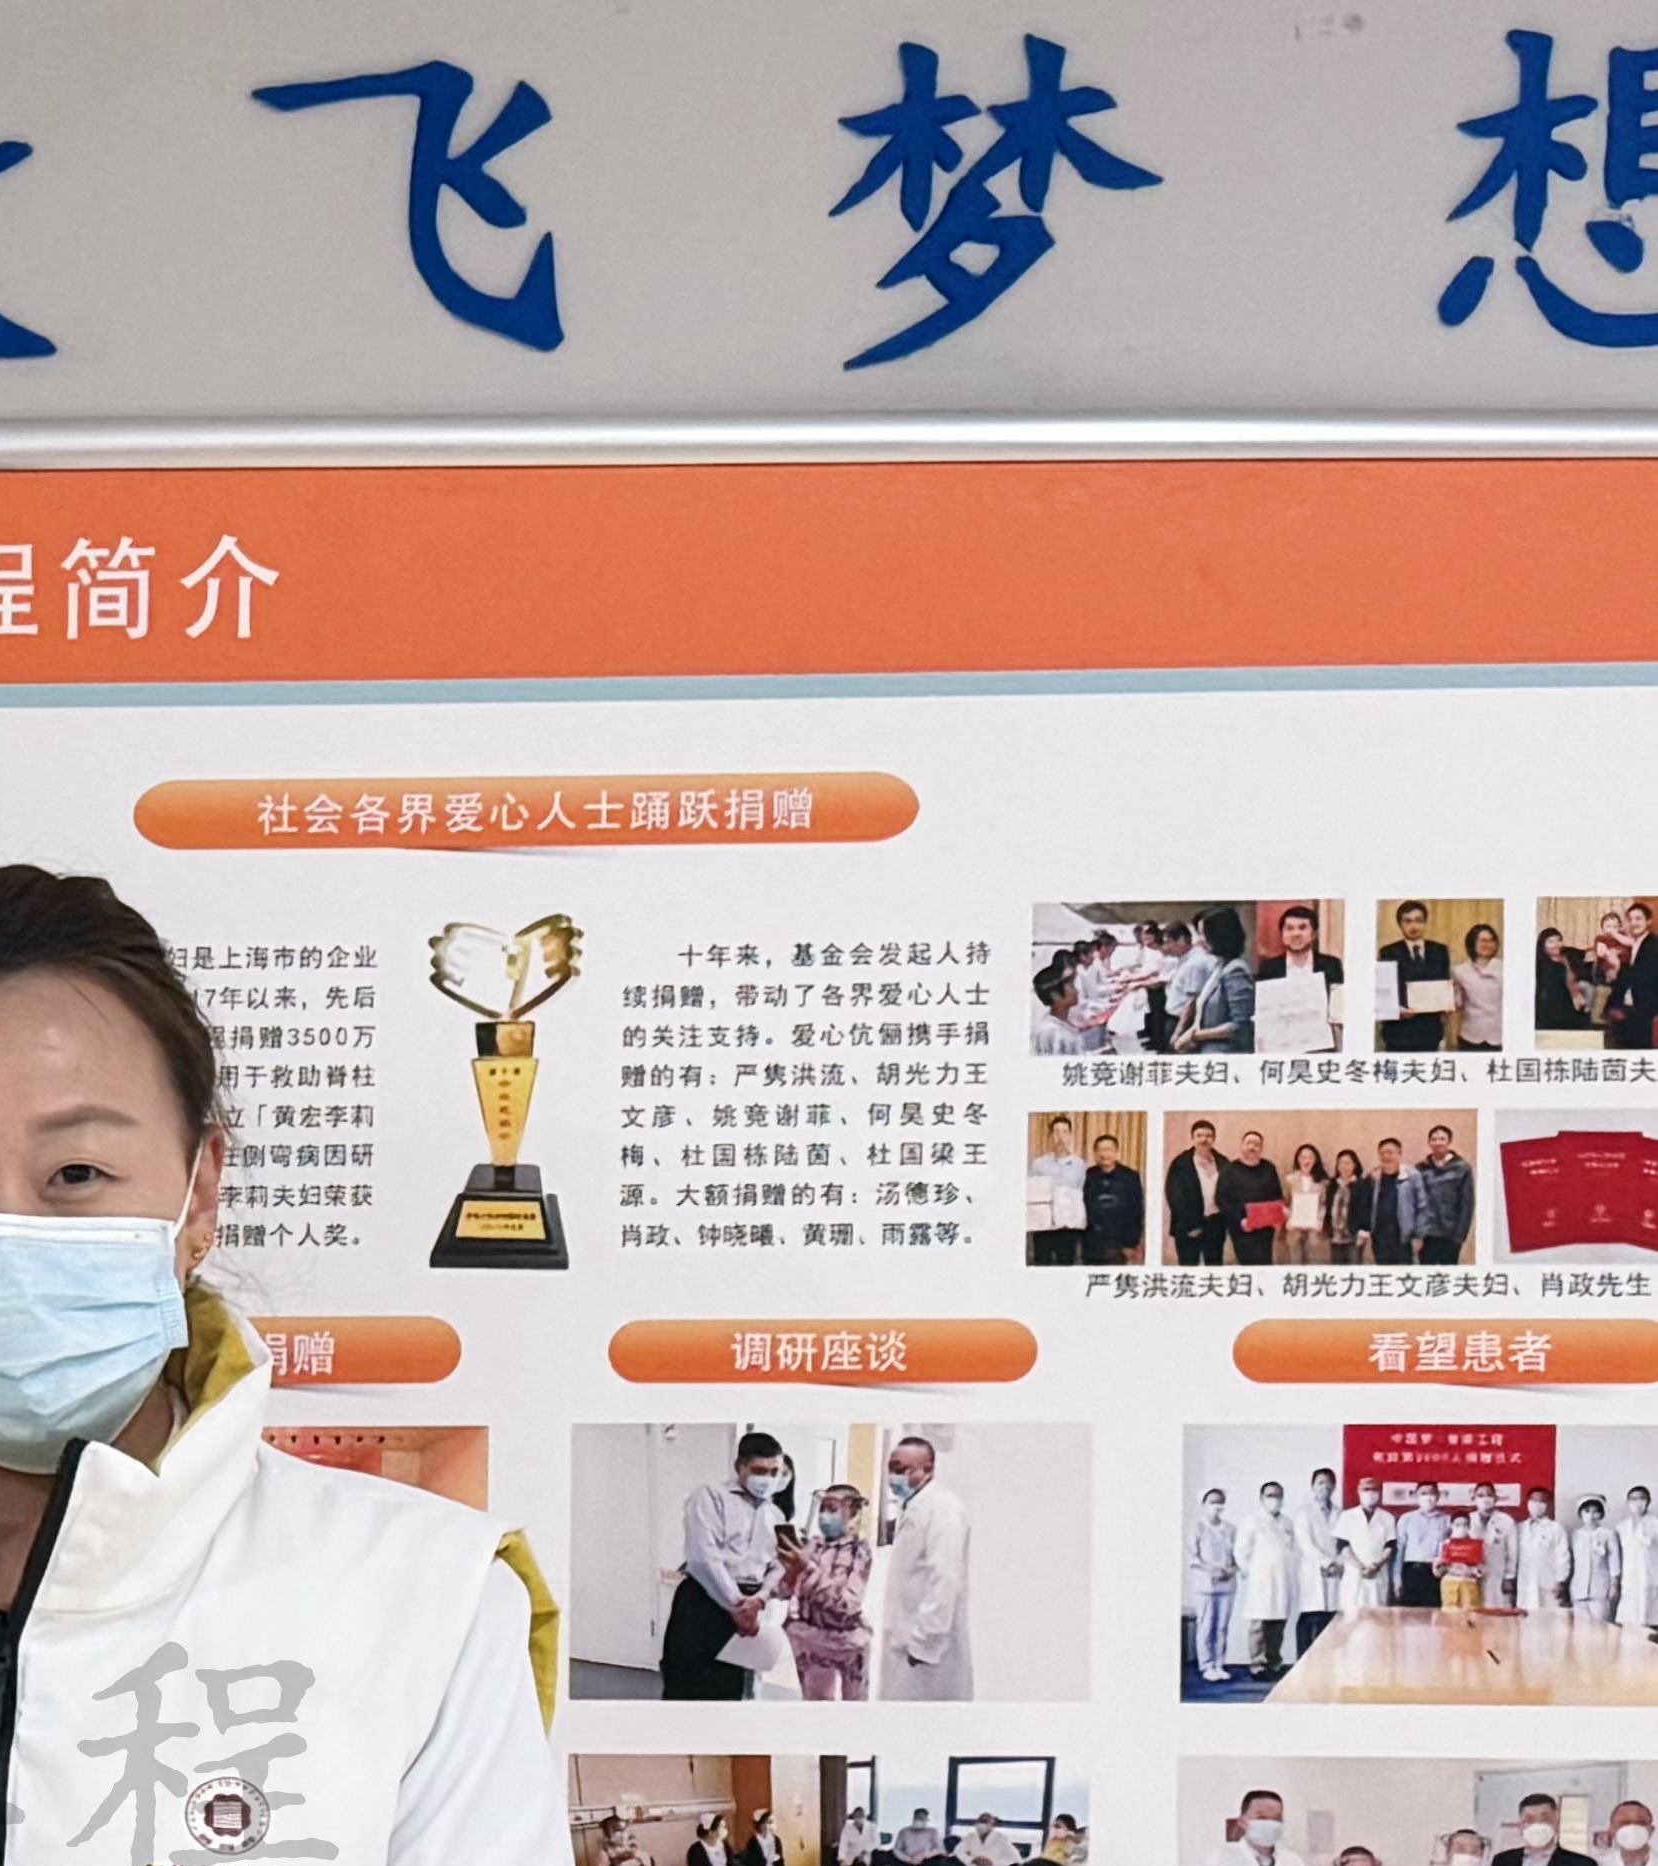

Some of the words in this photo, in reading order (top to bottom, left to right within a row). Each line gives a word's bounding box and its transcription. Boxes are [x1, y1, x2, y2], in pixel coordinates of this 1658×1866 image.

[257, 788, 815, 836] 社会各界爱心人士踊跃捐赠
[731, 1330, 909, 1373] 调研座谈
[1367, 1330, 1552, 1374] 看望患者
